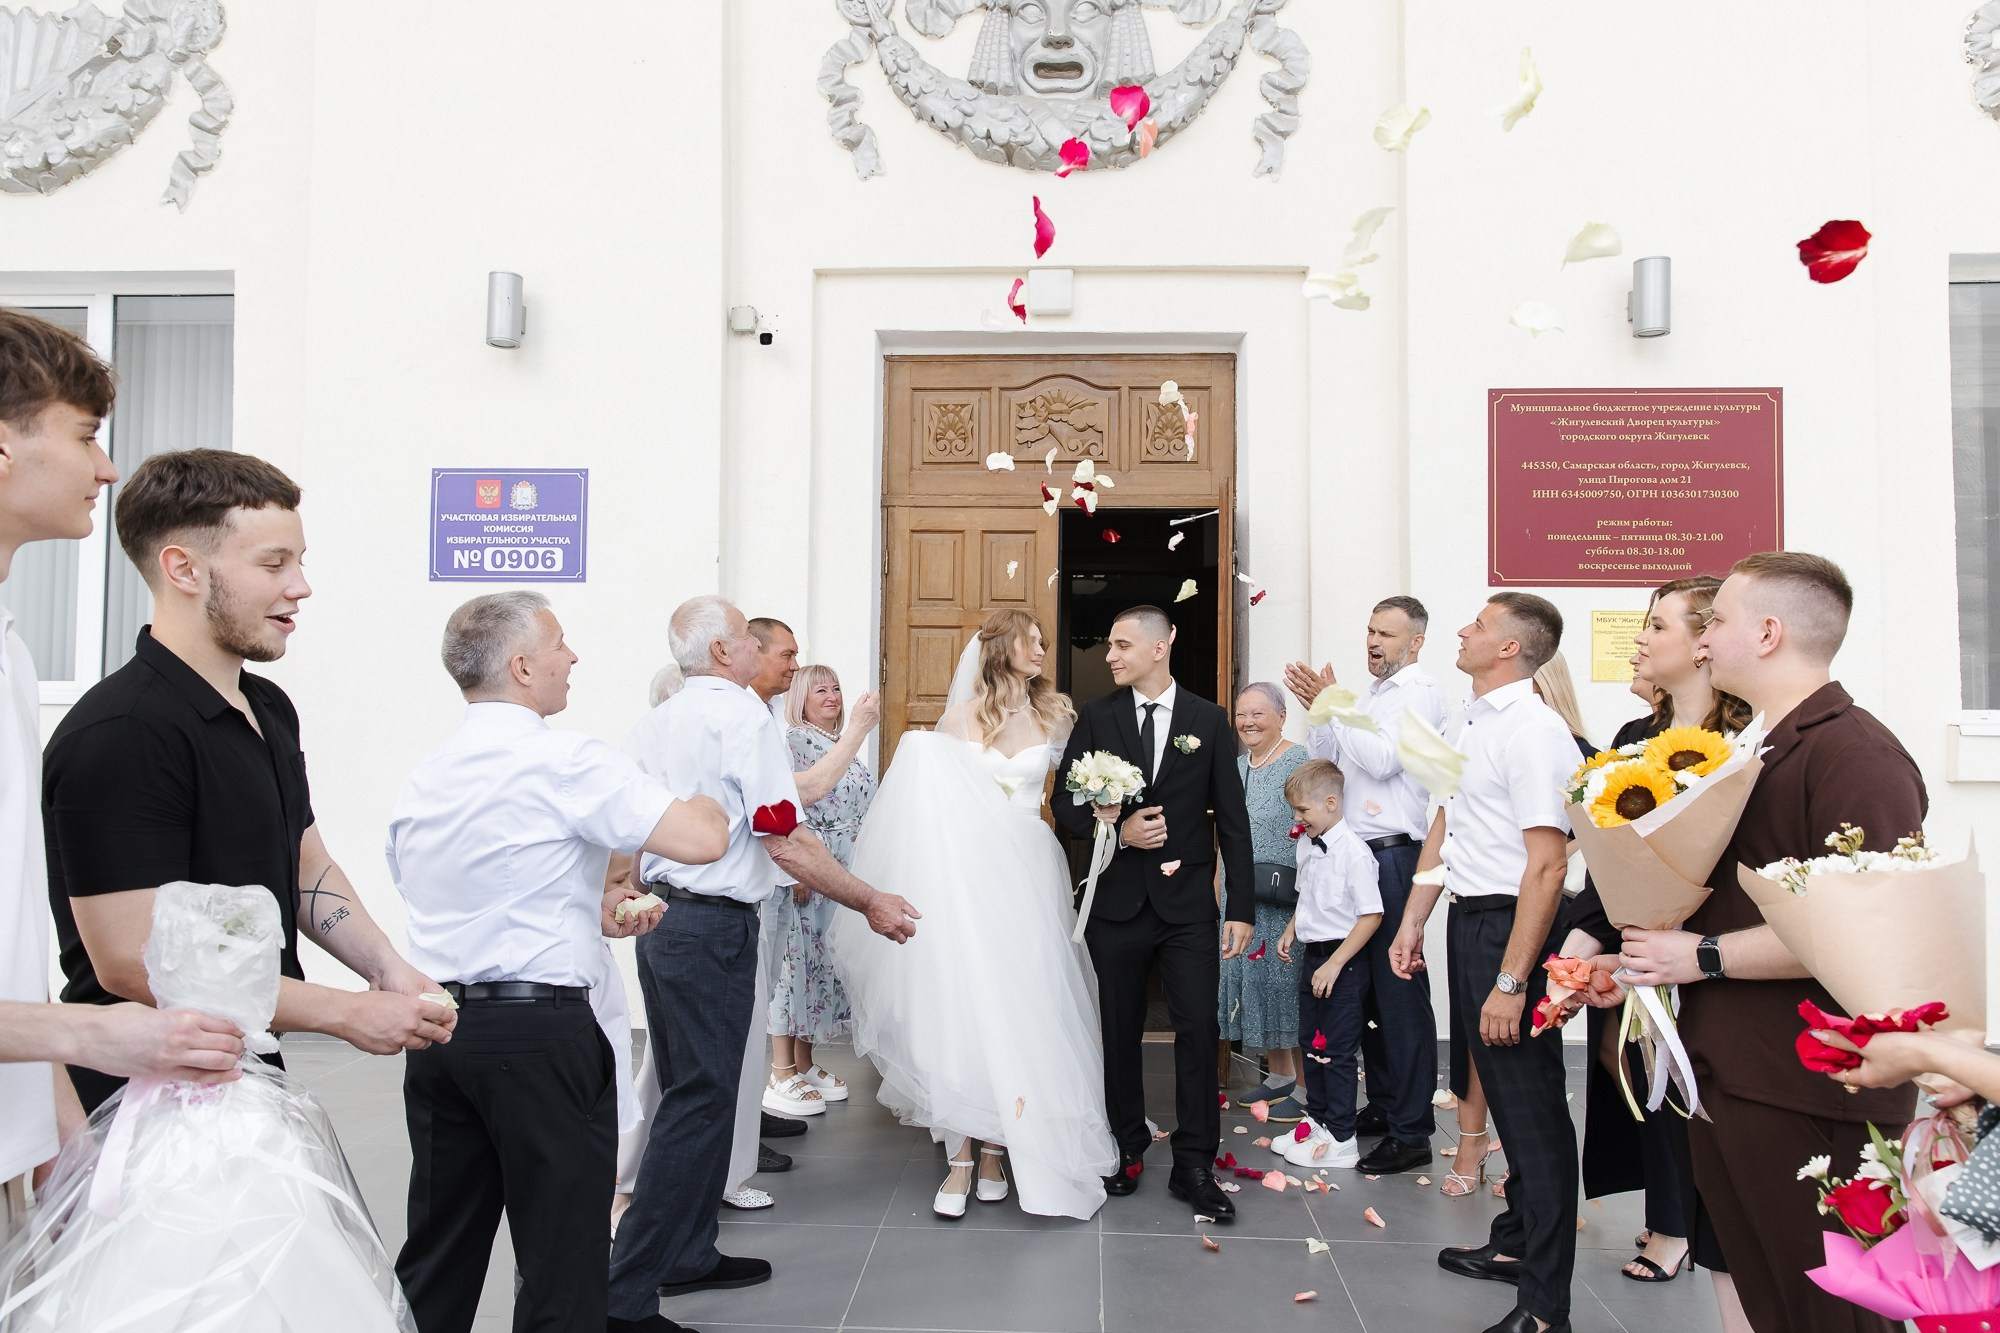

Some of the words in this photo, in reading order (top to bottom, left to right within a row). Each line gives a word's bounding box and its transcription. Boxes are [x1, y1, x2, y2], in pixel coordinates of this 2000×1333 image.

[1510, 404, 1590, 414] Муниципальное
[1593, 403, 1649, 413] бюджетное
[1652, 405, 1711, 413] учреждение
[1714, 405, 1760, 413] культуры
[1550, 418, 1624, 428] «Жигулевский
[1627, 418, 1664, 428] Дворец
[1667, 420, 1720, 428] культуры»
[1619, 434, 1652, 442] округа
[1654, 432, 1709, 442] Жигулевск
[1521, 461, 1560, 471] 445350,
[1563, 461, 1615, 471] Самарская
[1618, 461, 1659, 470] область,
[1661, 463, 1690, 471] город
[1692, 461, 1750, 471] Жигулевск,
[1578, 478, 1606, 486] улица
[1609, 475, 1657, 486] Пирогова
[1532, 490, 1559, 498] ИНН
[1561, 490, 1624, 499] 6345009750,
[1627, 490, 1658, 498] ОГРН
[1661, 490, 1739, 498] 1036301730300
[441, 513, 498, 522] УЧАСТКОВАЯ
[501, 514, 577, 522] ИЗБИРАТЕЛЬНАЯ
[1597, 520, 1630, 528] режим
[1632, 518, 1672, 528] работы:
[484, 525, 533, 533] КОМИССИЯ
[447, 536, 528, 544] ИЗБИРАТЕЛЬНОГО
[1665, 533, 1723, 541] 08.30-21.00
[1586, 546, 1624, 557] суббота
[1627, 547, 1685, 555] 08.30-18.00
[453, 549, 482, 568] №
[491, 550, 556, 569] 0906
[1578, 564, 1640, 572] воскресенье
[1642, 562, 1691, 571] выходной
[321, 906, 350, 935] 生活
